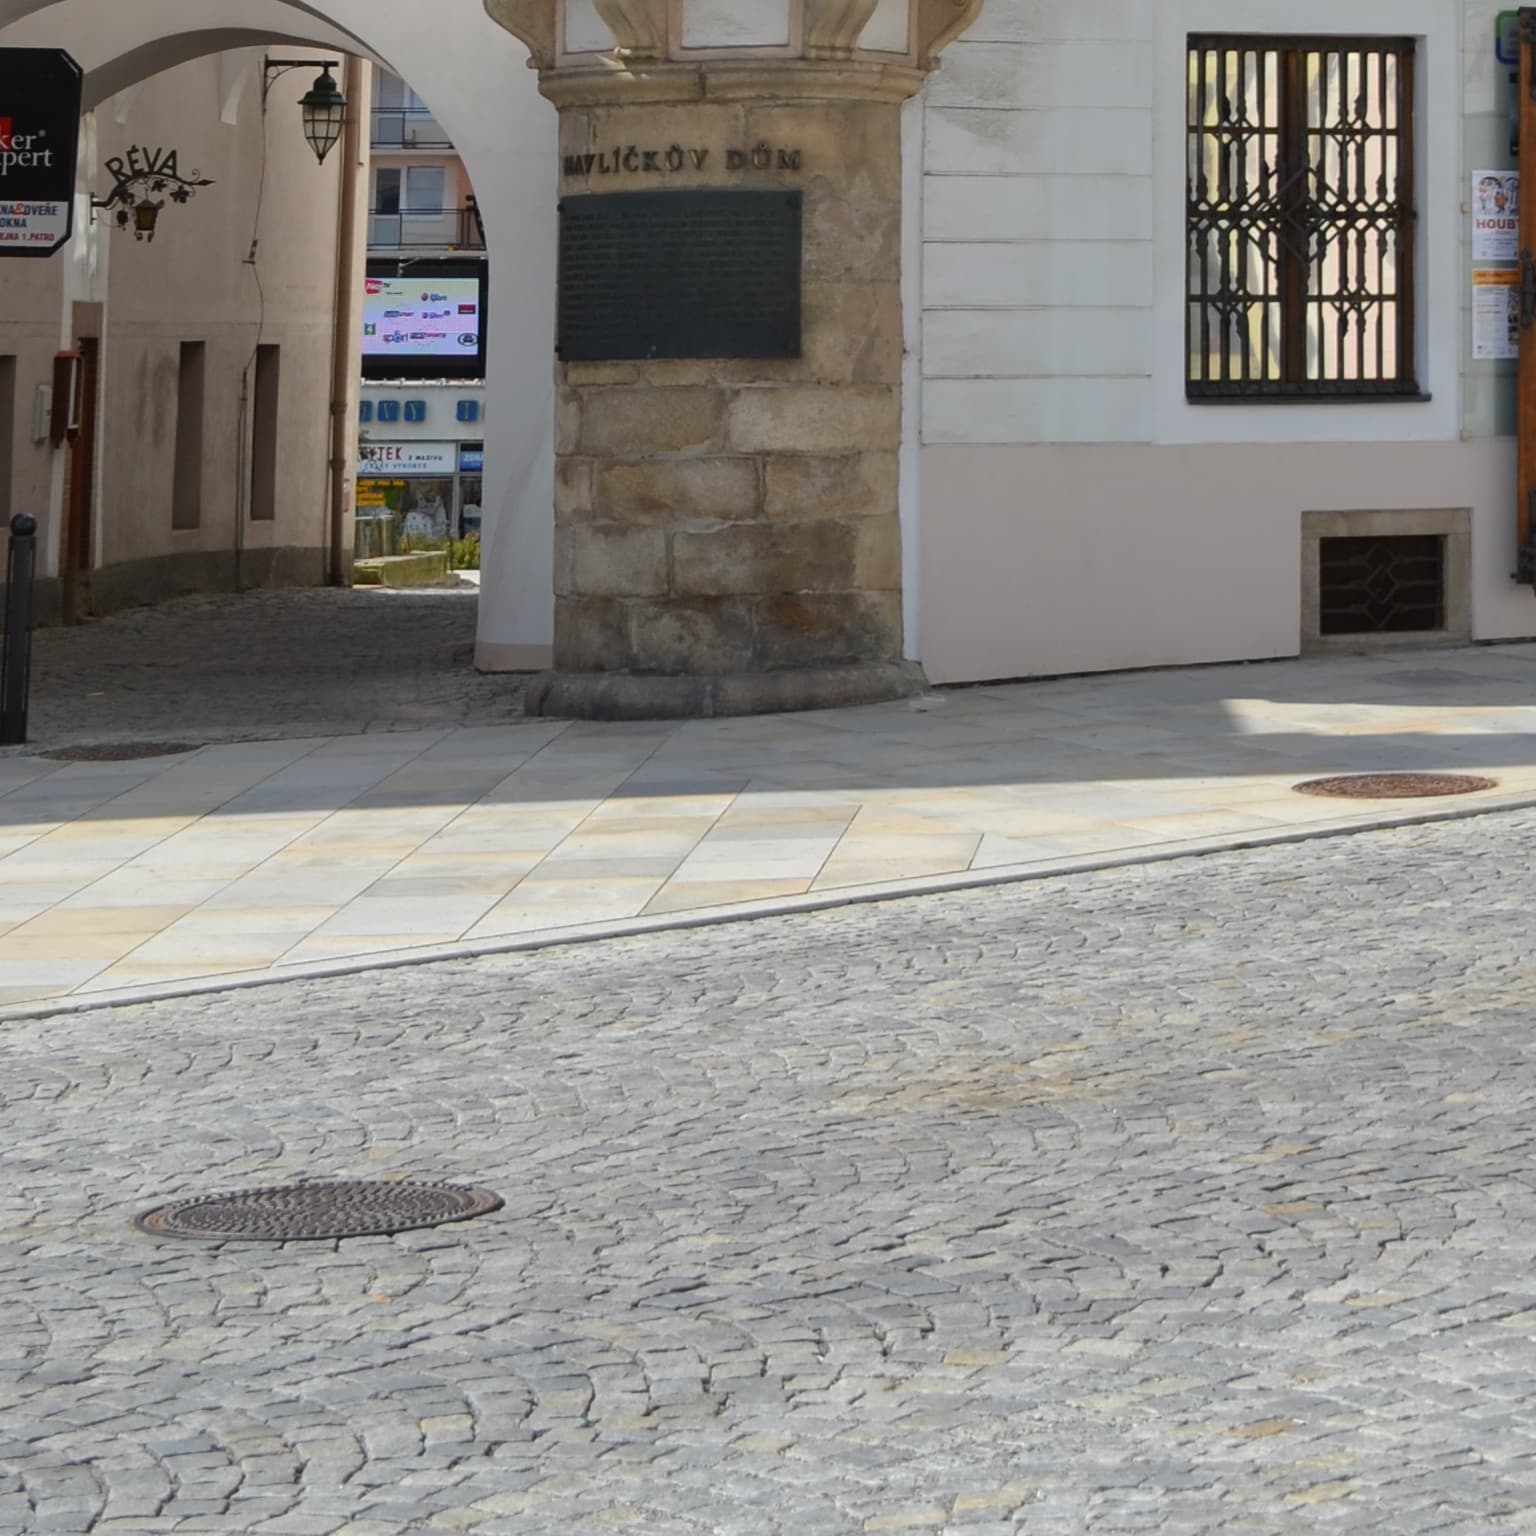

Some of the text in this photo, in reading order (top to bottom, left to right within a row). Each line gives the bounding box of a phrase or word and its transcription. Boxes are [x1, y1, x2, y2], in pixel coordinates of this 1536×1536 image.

[104, 144, 177, 184] RÉVA
[563, 142, 802, 177] HAVLÍČKŮV DŮM
